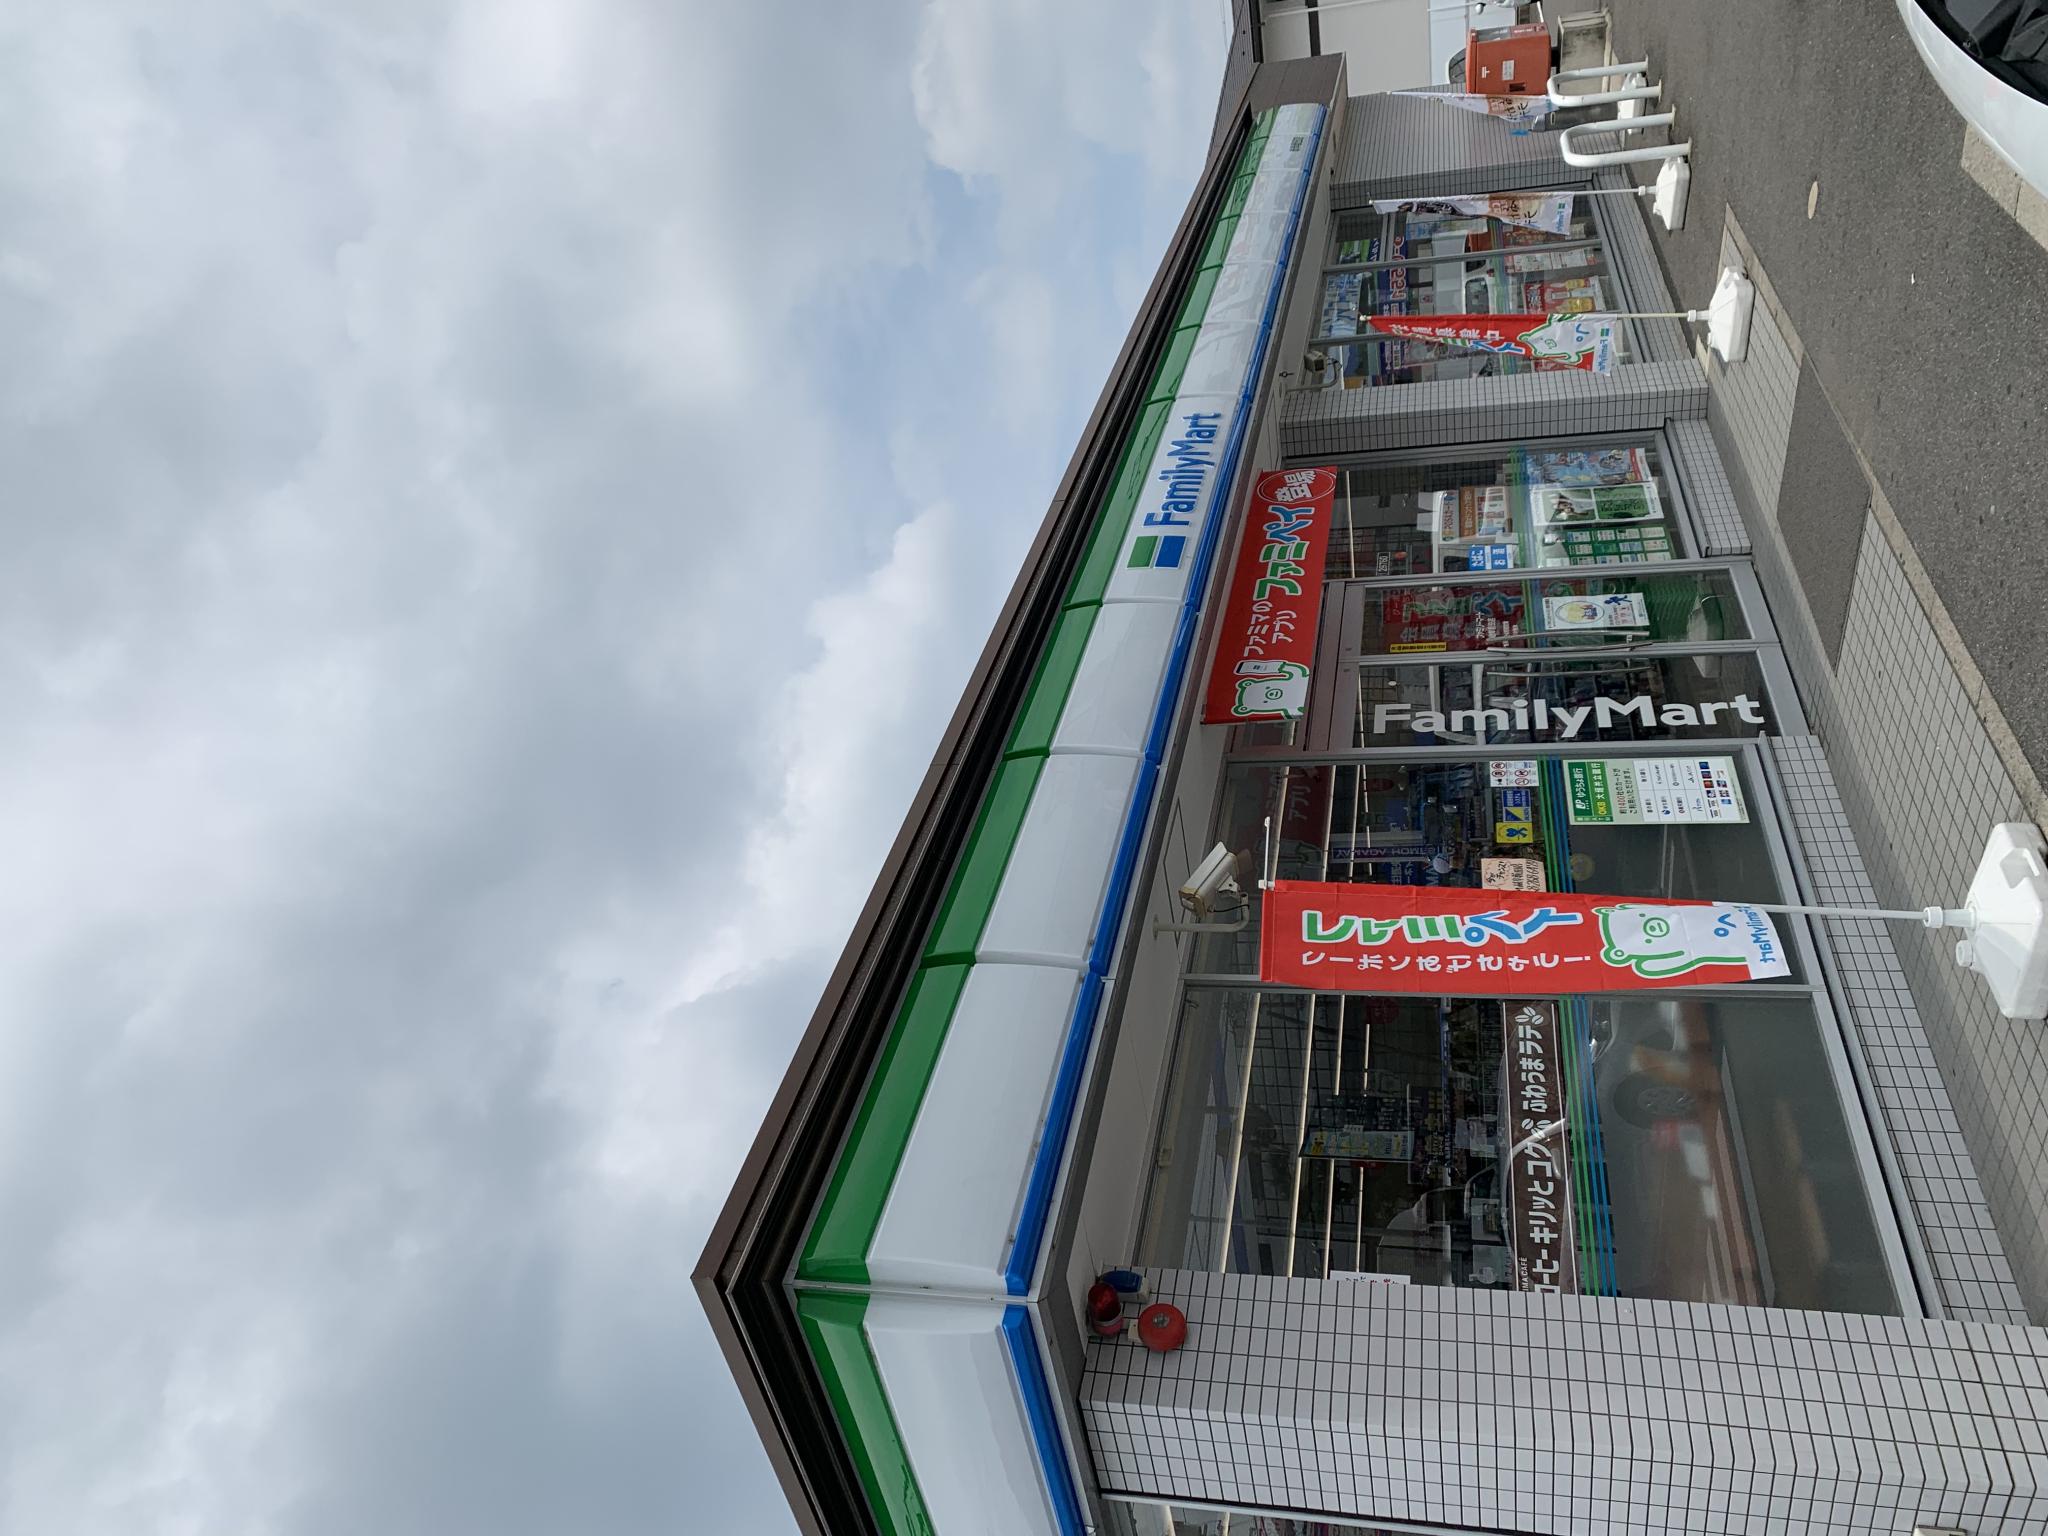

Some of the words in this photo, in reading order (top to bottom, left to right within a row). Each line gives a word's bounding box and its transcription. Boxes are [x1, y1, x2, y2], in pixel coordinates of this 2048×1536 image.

[1143, 412, 1221, 526] FamilyMart
[1275, 470, 1316, 501] 登場
[1253, 505, 1315, 601] ファミペイ
[1471, 550, 1484, 567] たばこ
[1243, 600, 1273, 657] ファミマの
[1272, 610, 1297, 644] アプリ
[1373, 693, 1765, 737] FamilyMart
[1573, 768, 1586, 798] ゆうちょ銀行
[1518, 1025, 1547, 1112] ふわうまラテ
